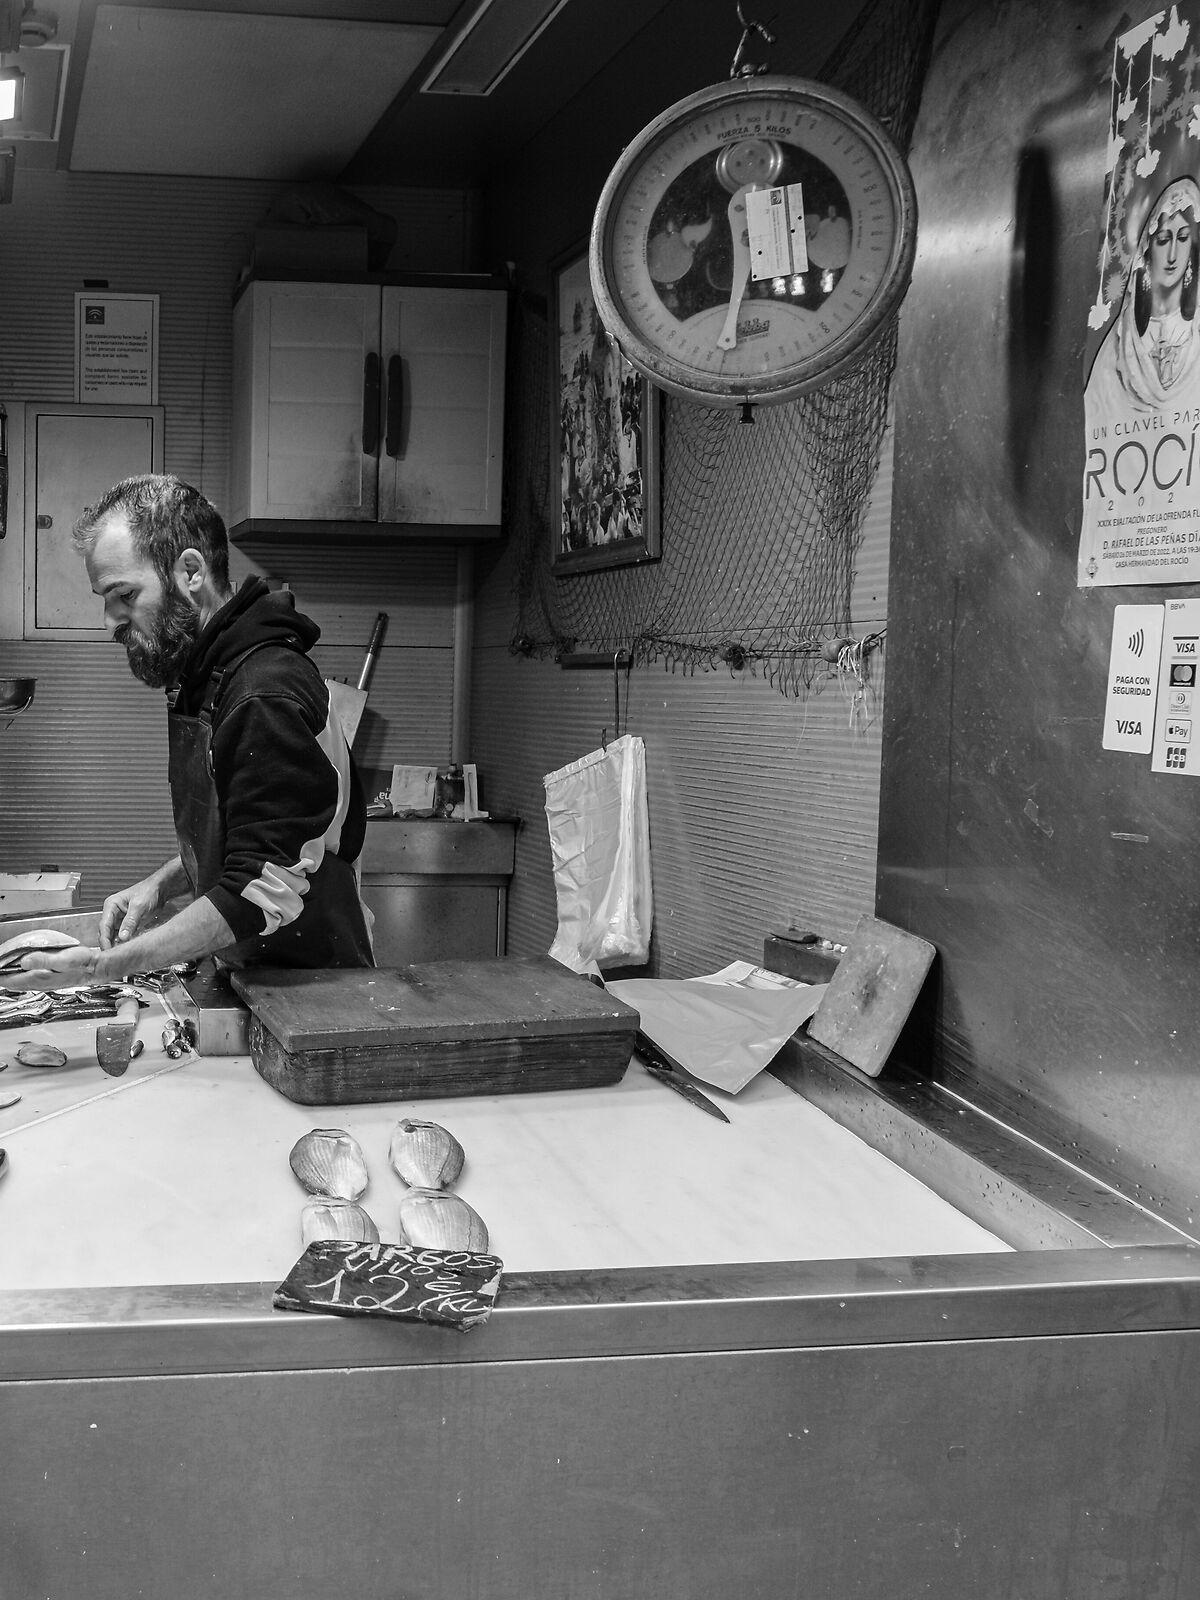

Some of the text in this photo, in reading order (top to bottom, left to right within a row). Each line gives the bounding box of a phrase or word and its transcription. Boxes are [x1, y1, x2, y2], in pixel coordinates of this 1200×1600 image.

[717, 126, 749, 140] FUERZA
[766, 125, 791, 135] KILOS
[1093, 426, 1107, 440] UN
[1114, 415, 1165, 436] CLAVEL
[1086, 423, 1200, 500] ROCÍ
[1097, 519, 1112, 527] XXIX
[1112, 514, 1146, 527] EXALTACIÓN
[1146, 514, 1155, 522] DE
[1155, 512, 1163, 521] LA
[1163, 510, 1191, 521] OFRENDA
[1137, 526, 1168, 535] PREGONERO
[1111, 538, 1134, 549] RAFAEL
[1135, 537, 1145, 547] DE
[1145, 535, 1160, 545] LAS
[1161, 532, 1186, 545] PEÑAS
[1176, 546, 1187, 554] LAS
[1115, 560, 1129, 568] CASA
[1160, 558, 1170, 566] DEL
[1171, 556, 1189, 565] ROCÍO
[1176, 642, 1196, 653] VISA
[1115, 675, 1150, 686] PAGA CON
[1112, 686, 1152, 696] SEGURIDAD
[1115, 719, 1142, 736] VISA
[1174, 726, 1188, 738] Pay
[316, 1241, 498, 1270] PARGOS
[343, 1258, 462, 1281] VIVOS
[304, 1269, 418, 1313] 12
